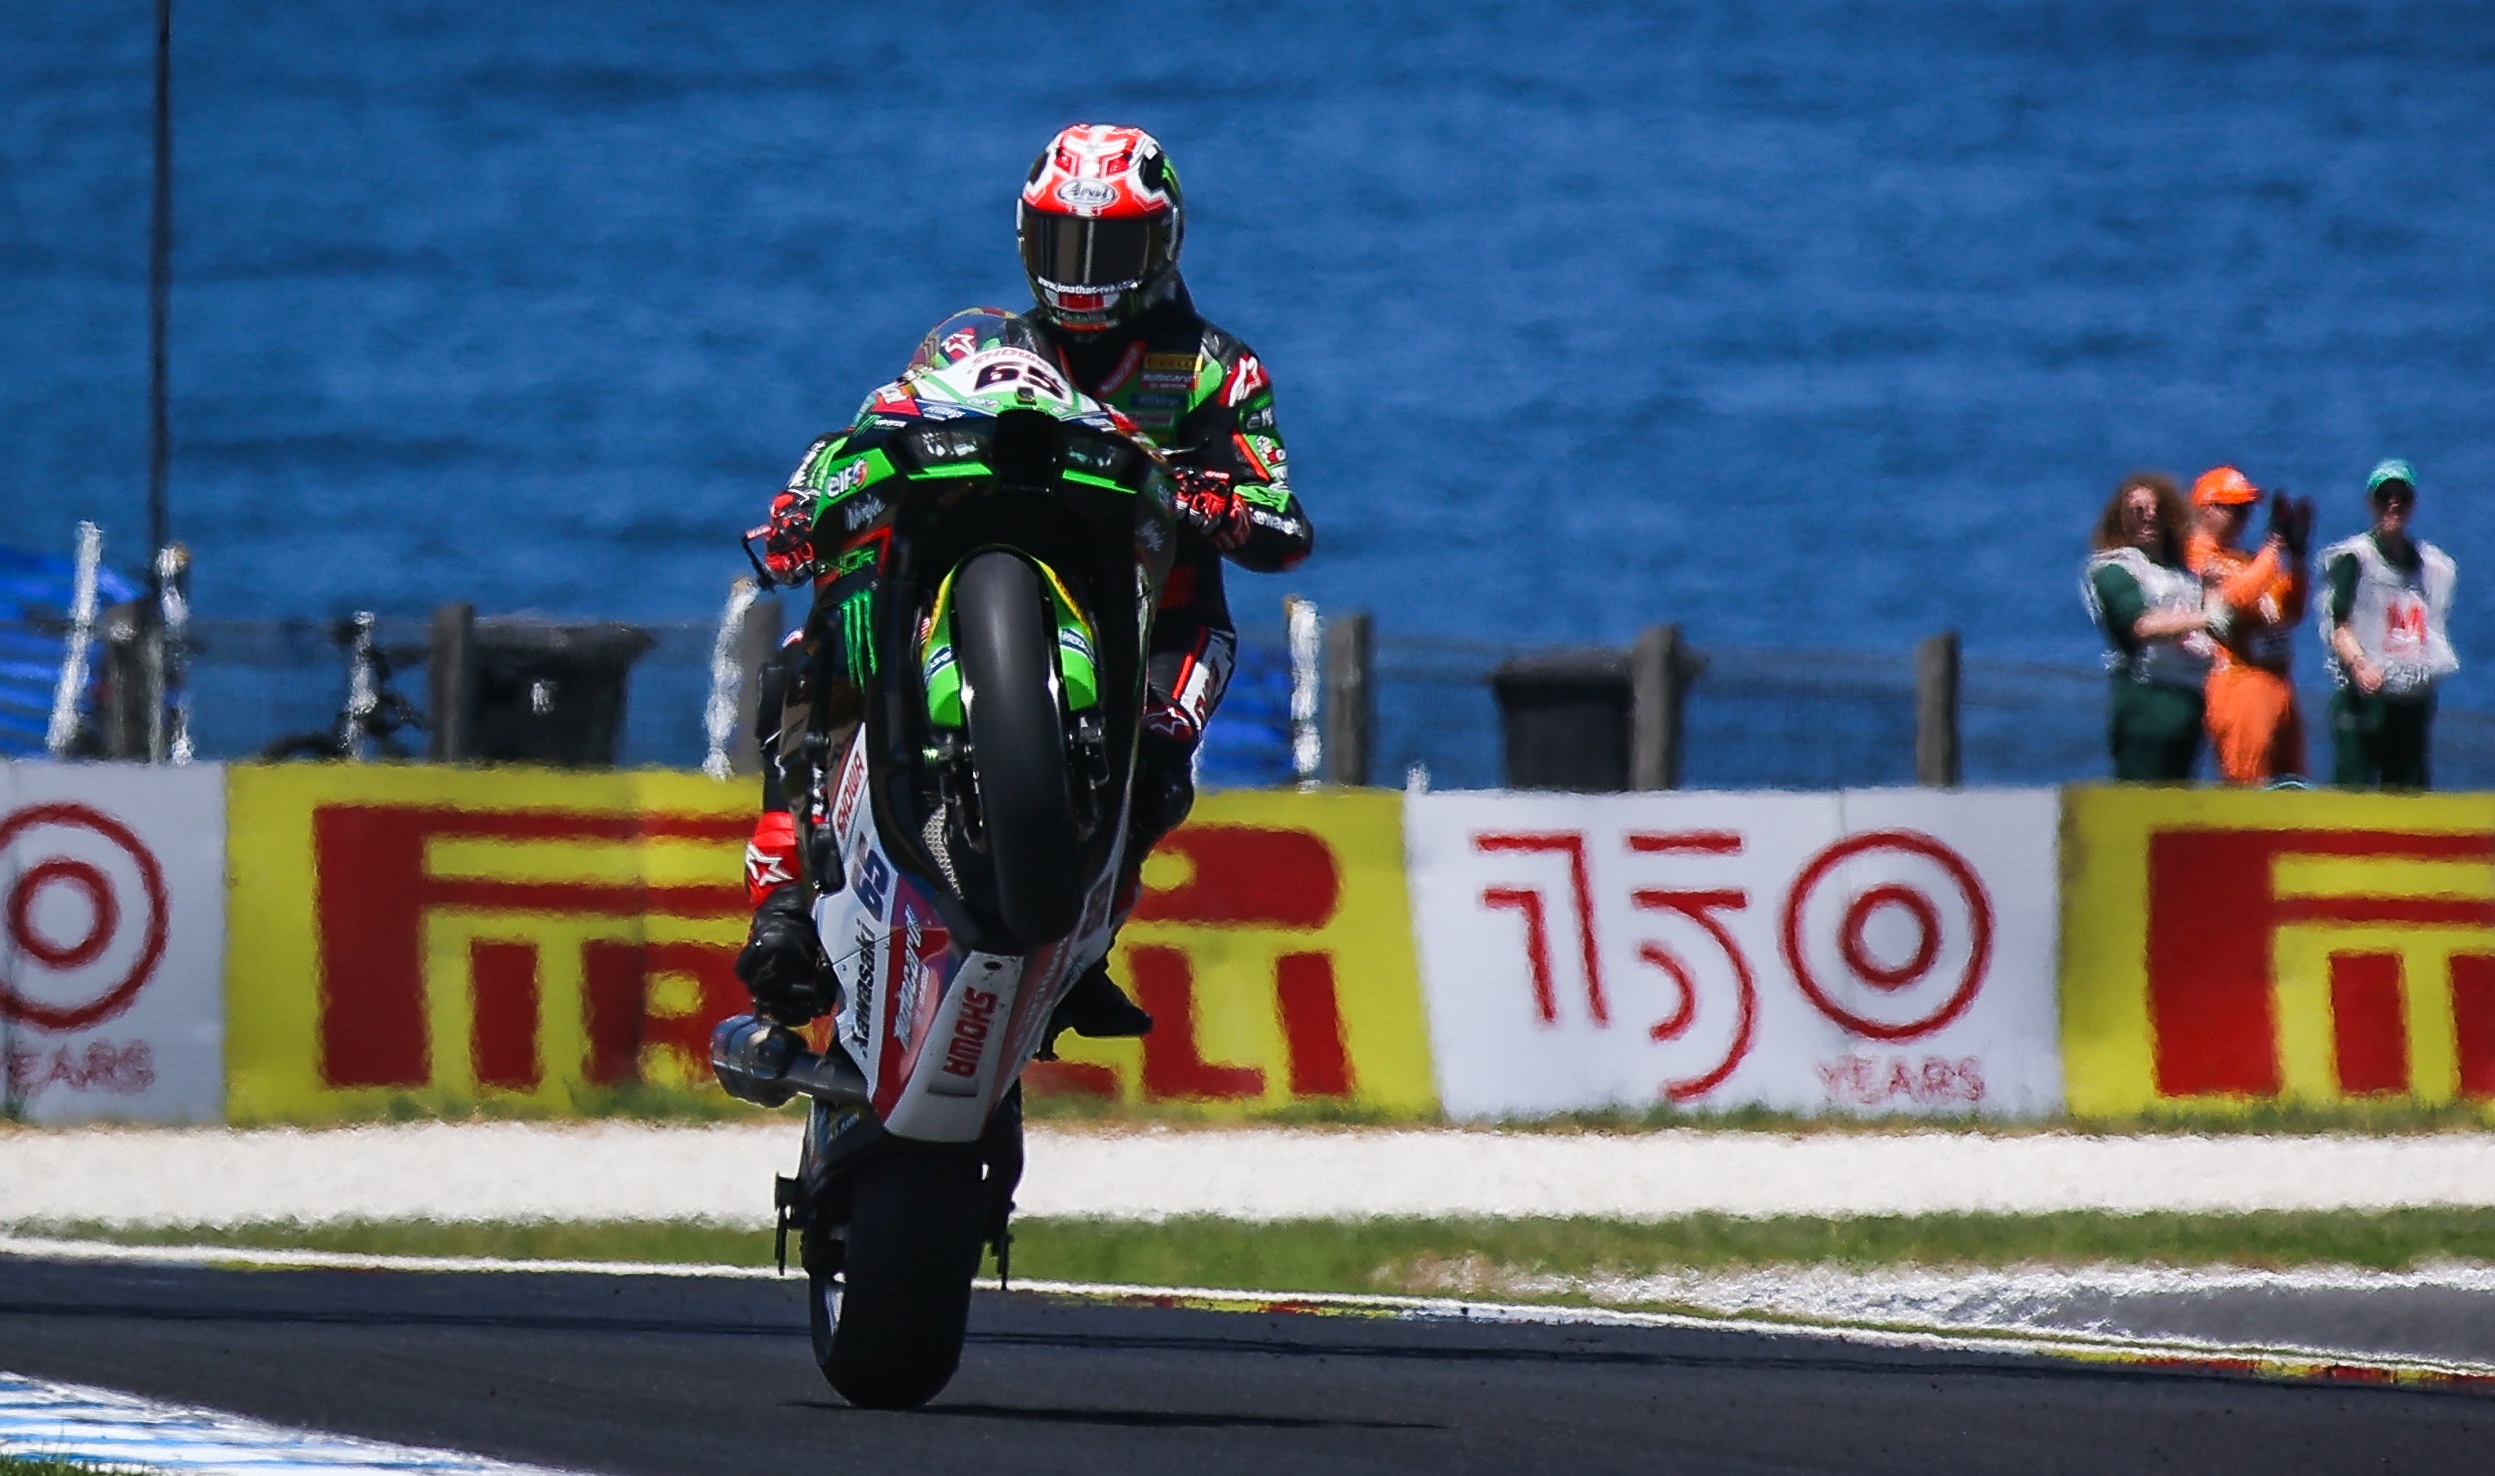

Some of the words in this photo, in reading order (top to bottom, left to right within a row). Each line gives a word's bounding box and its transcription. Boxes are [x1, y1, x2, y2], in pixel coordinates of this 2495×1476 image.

[974, 362, 1066, 400] 65
[851, 918, 876, 1059] Kawasaki
[1470, 827, 1996, 1104] 150
[942, 986, 999, 1079] SHOWA
[1816, 1054, 1986, 1104] YEARS
